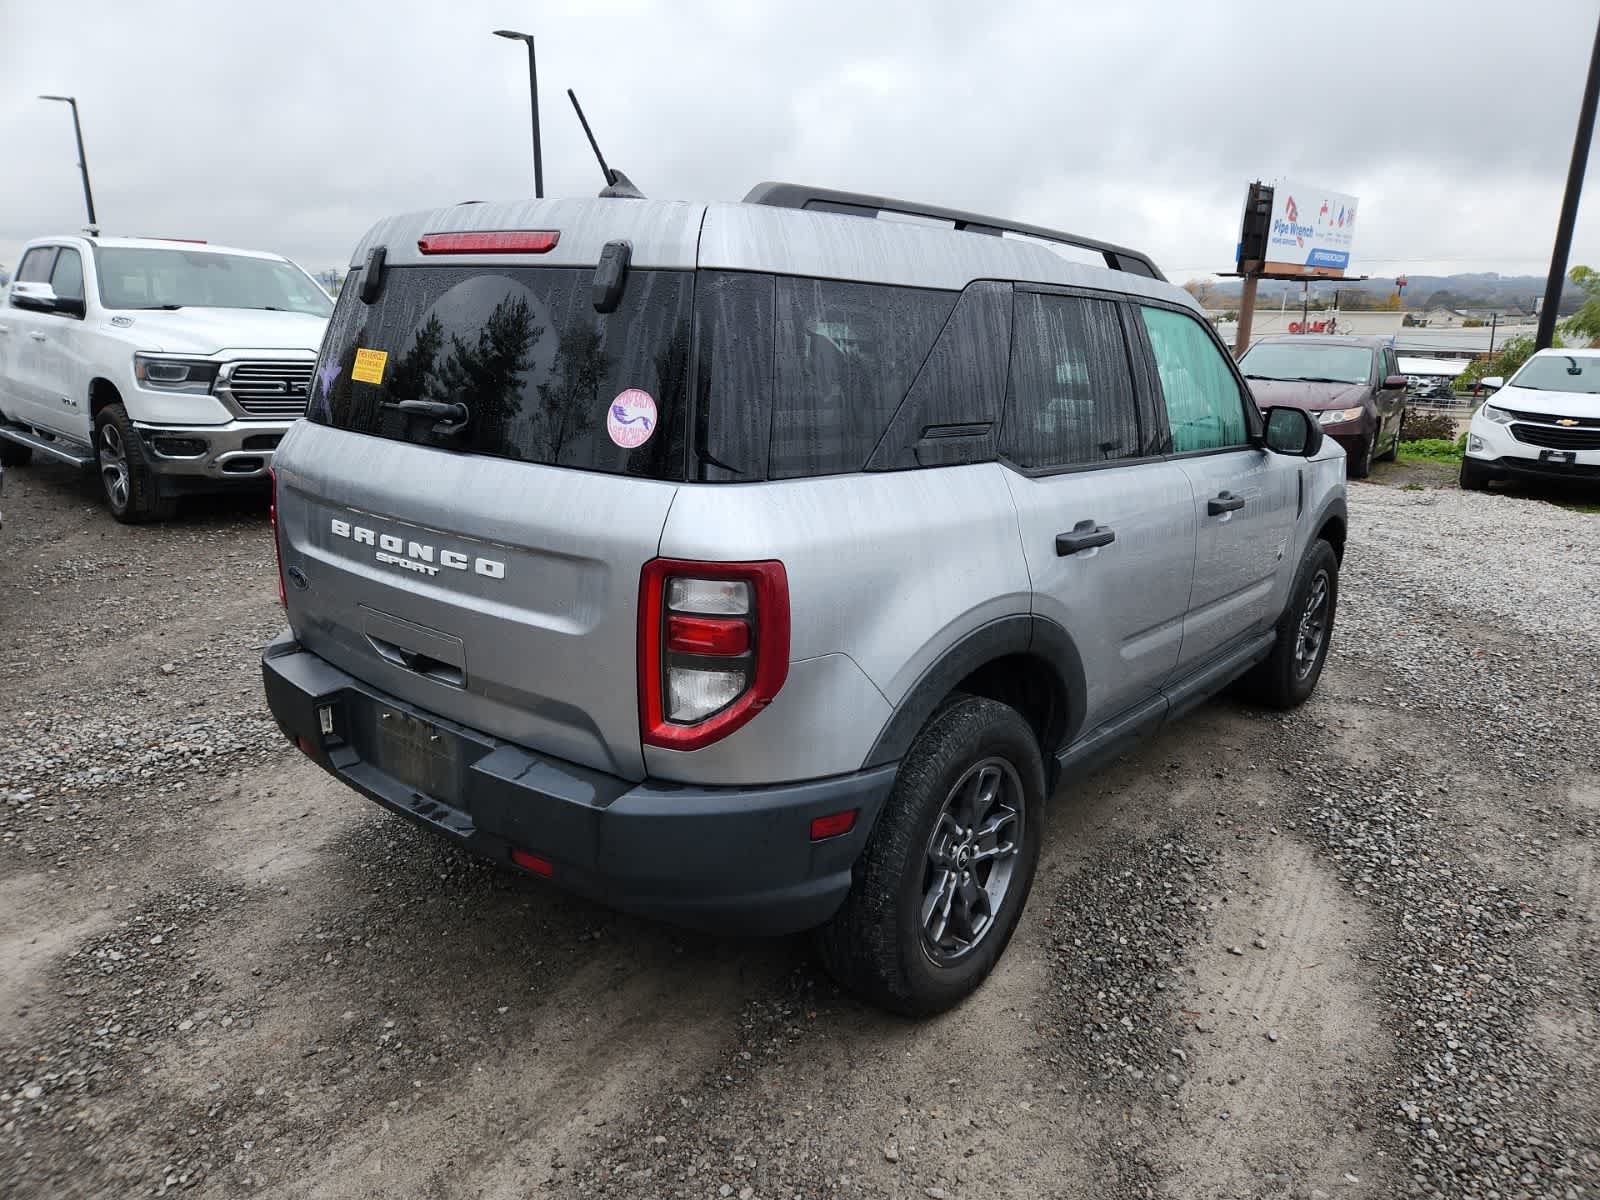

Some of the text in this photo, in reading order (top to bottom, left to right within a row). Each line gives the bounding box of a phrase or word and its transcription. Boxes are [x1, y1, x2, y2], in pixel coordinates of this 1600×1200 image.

[1273, 219, 1288, 236] Pipe
[1290, 223, 1313, 238] Wrench
[331, 519, 505, 579] BRONCO
[375, 551, 440, 576] SPORT
